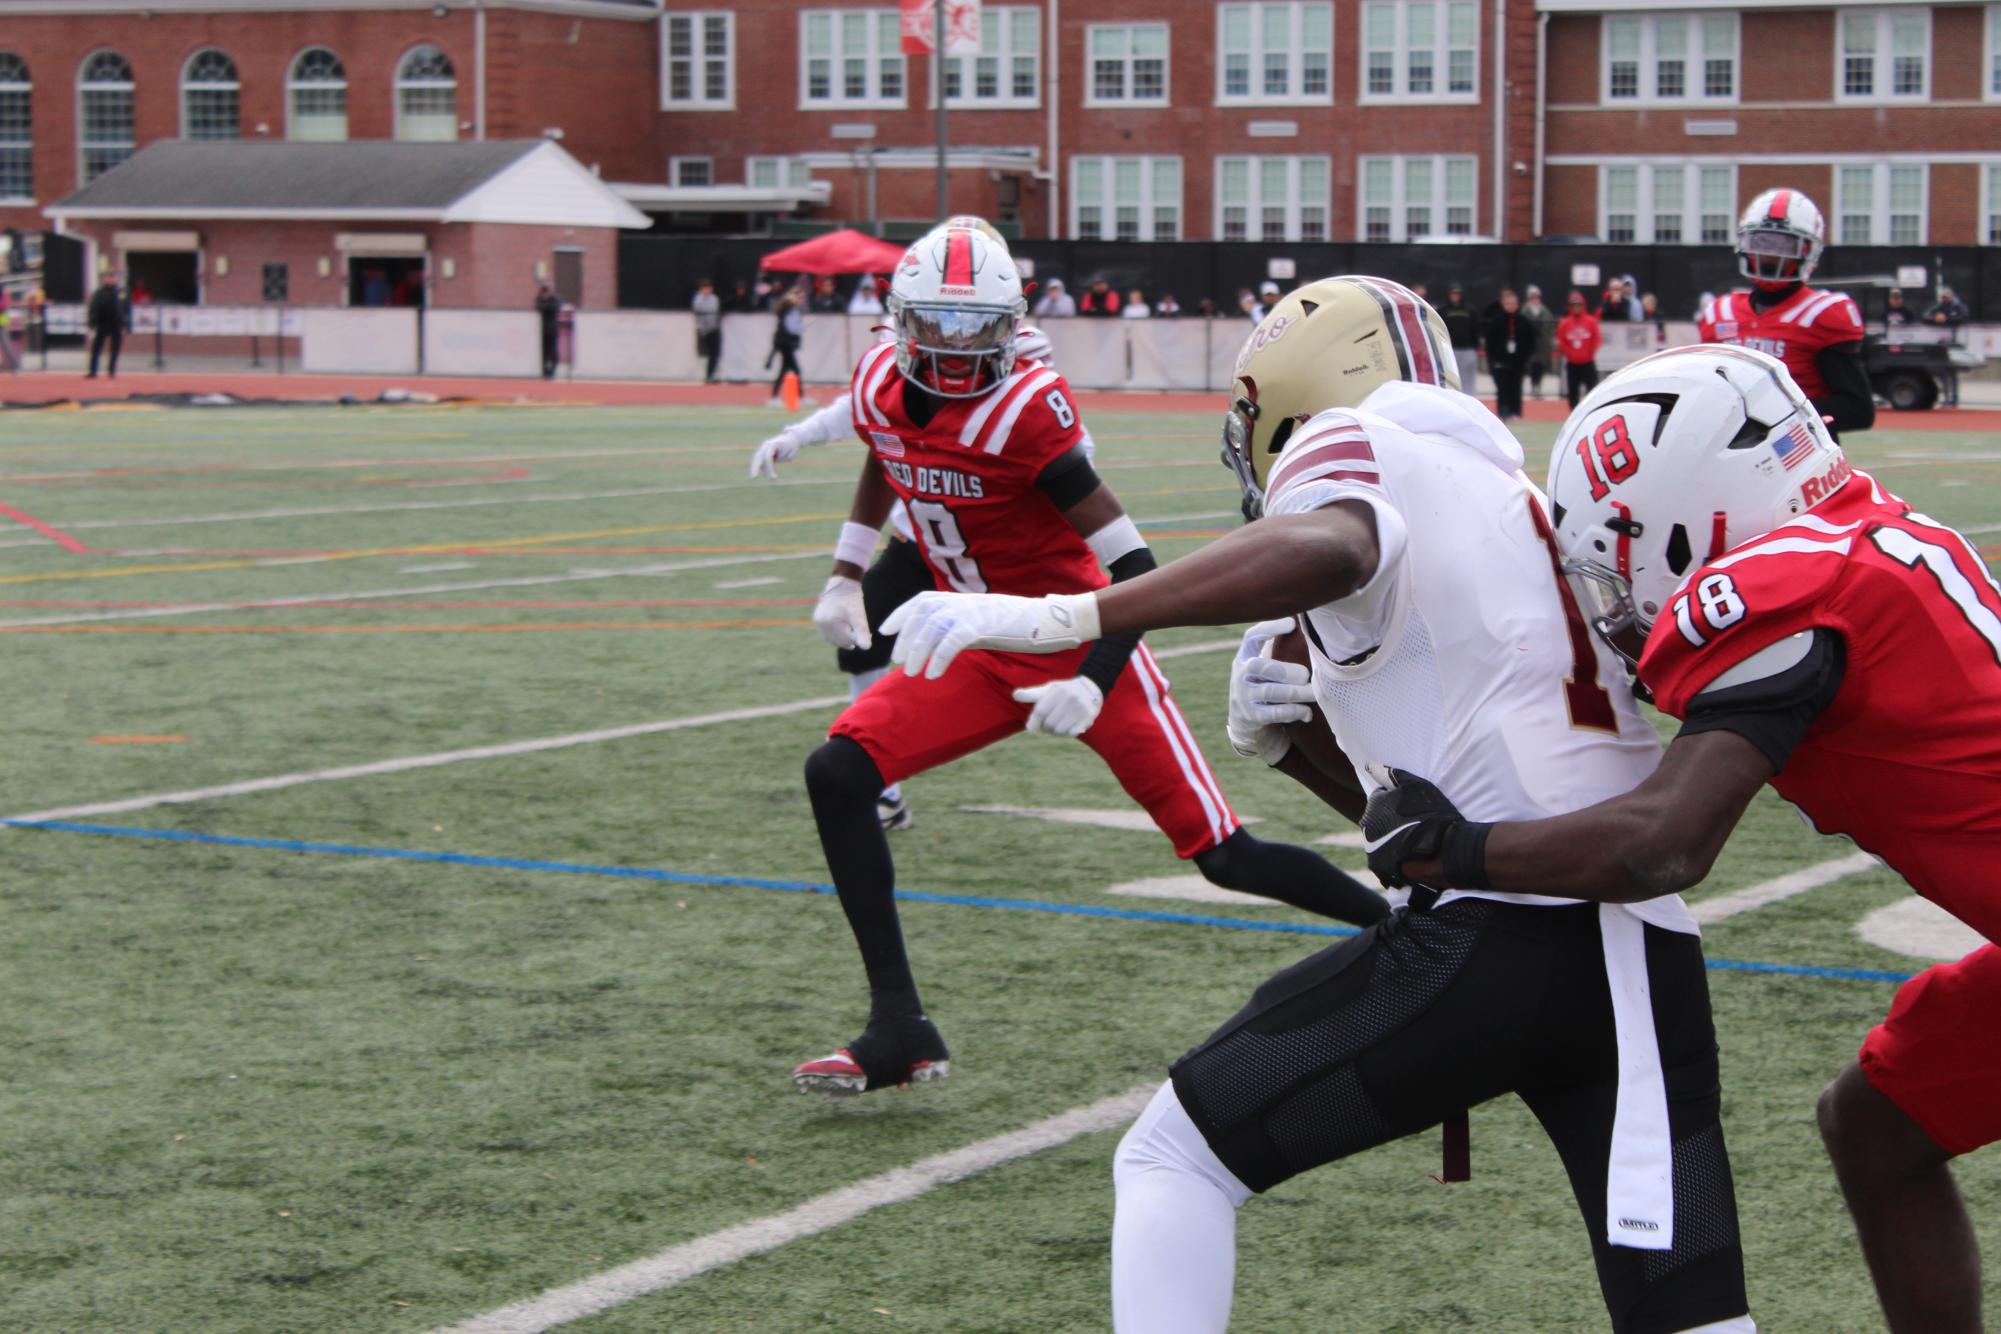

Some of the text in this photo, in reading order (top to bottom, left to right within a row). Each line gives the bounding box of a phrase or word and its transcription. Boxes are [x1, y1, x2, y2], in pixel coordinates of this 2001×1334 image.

[939, 287, 976, 296] Riddell
[1046, 389, 1075, 429] 8
[917, 466, 984, 498] DEVILS
[1575, 414, 1640, 502] 18
[1801, 456, 1850, 508] Ridd
[908, 498, 988, 594] 8
[1673, 572, 1748, 649] 18
[1867, 511, 2001, 667] 1
